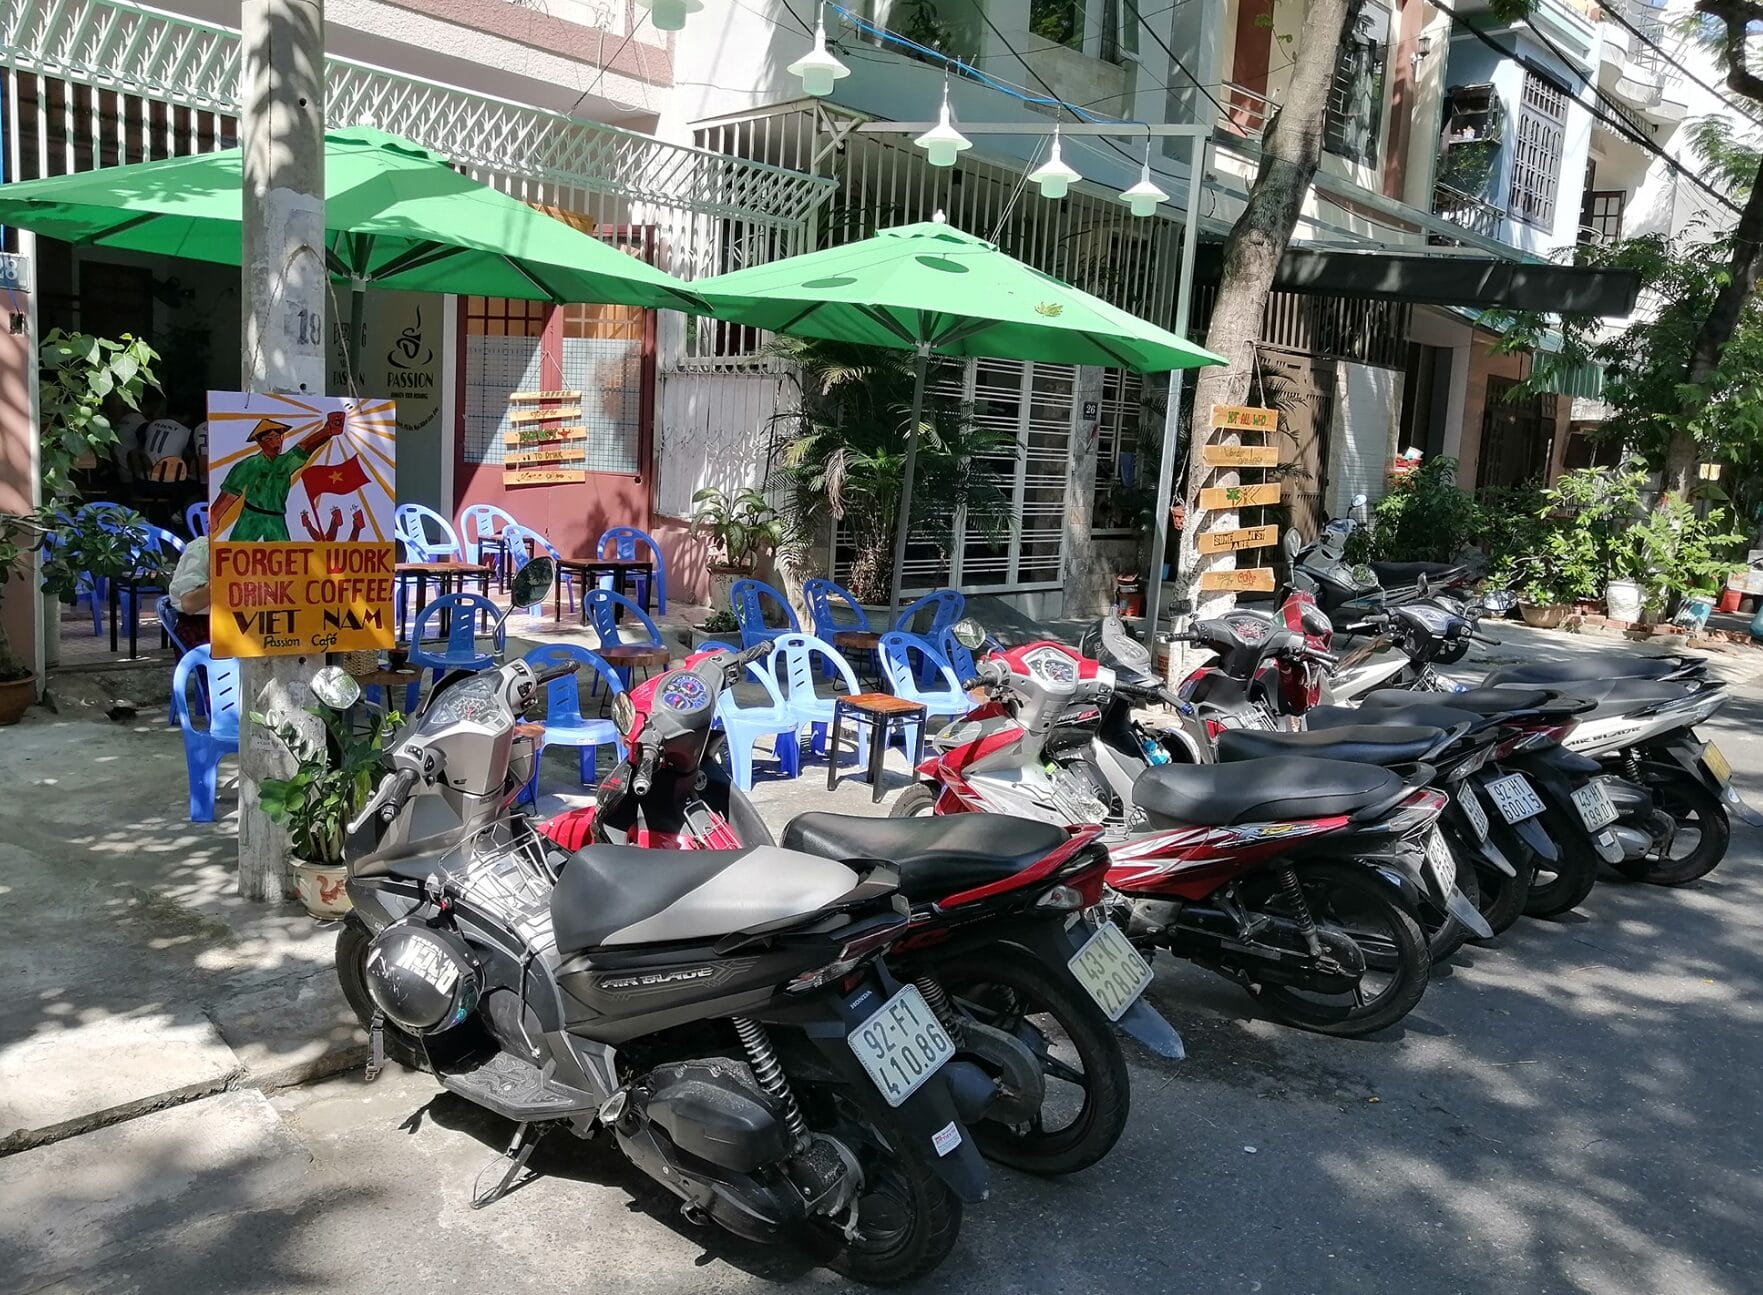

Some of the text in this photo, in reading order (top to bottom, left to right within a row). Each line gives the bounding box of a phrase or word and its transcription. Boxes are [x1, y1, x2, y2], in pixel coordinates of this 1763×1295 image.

[387, 371, 434, 388] PASSION
[1086, 404, 1096, 414] 26
[215, 548, 314, 577] FORGET
[229, 577, 395, 608] DRINK COFFEE!
[232, 607, 383, 635] VIET NAM
[263, 632, 337, 653] Passion Café
[1502, 794, 1541, 820] 600.15
[1078, 931, 1122, 981] 43-K1
[601, 967, 714, 989] AIR BLADE
[1096, 953, 1149, 1014] 228.09
[849, 989, 873, 1010] HONDA
[862, 998, 922, 1061] 92-F1
[878, 1023, 948, 1096] 410.86
